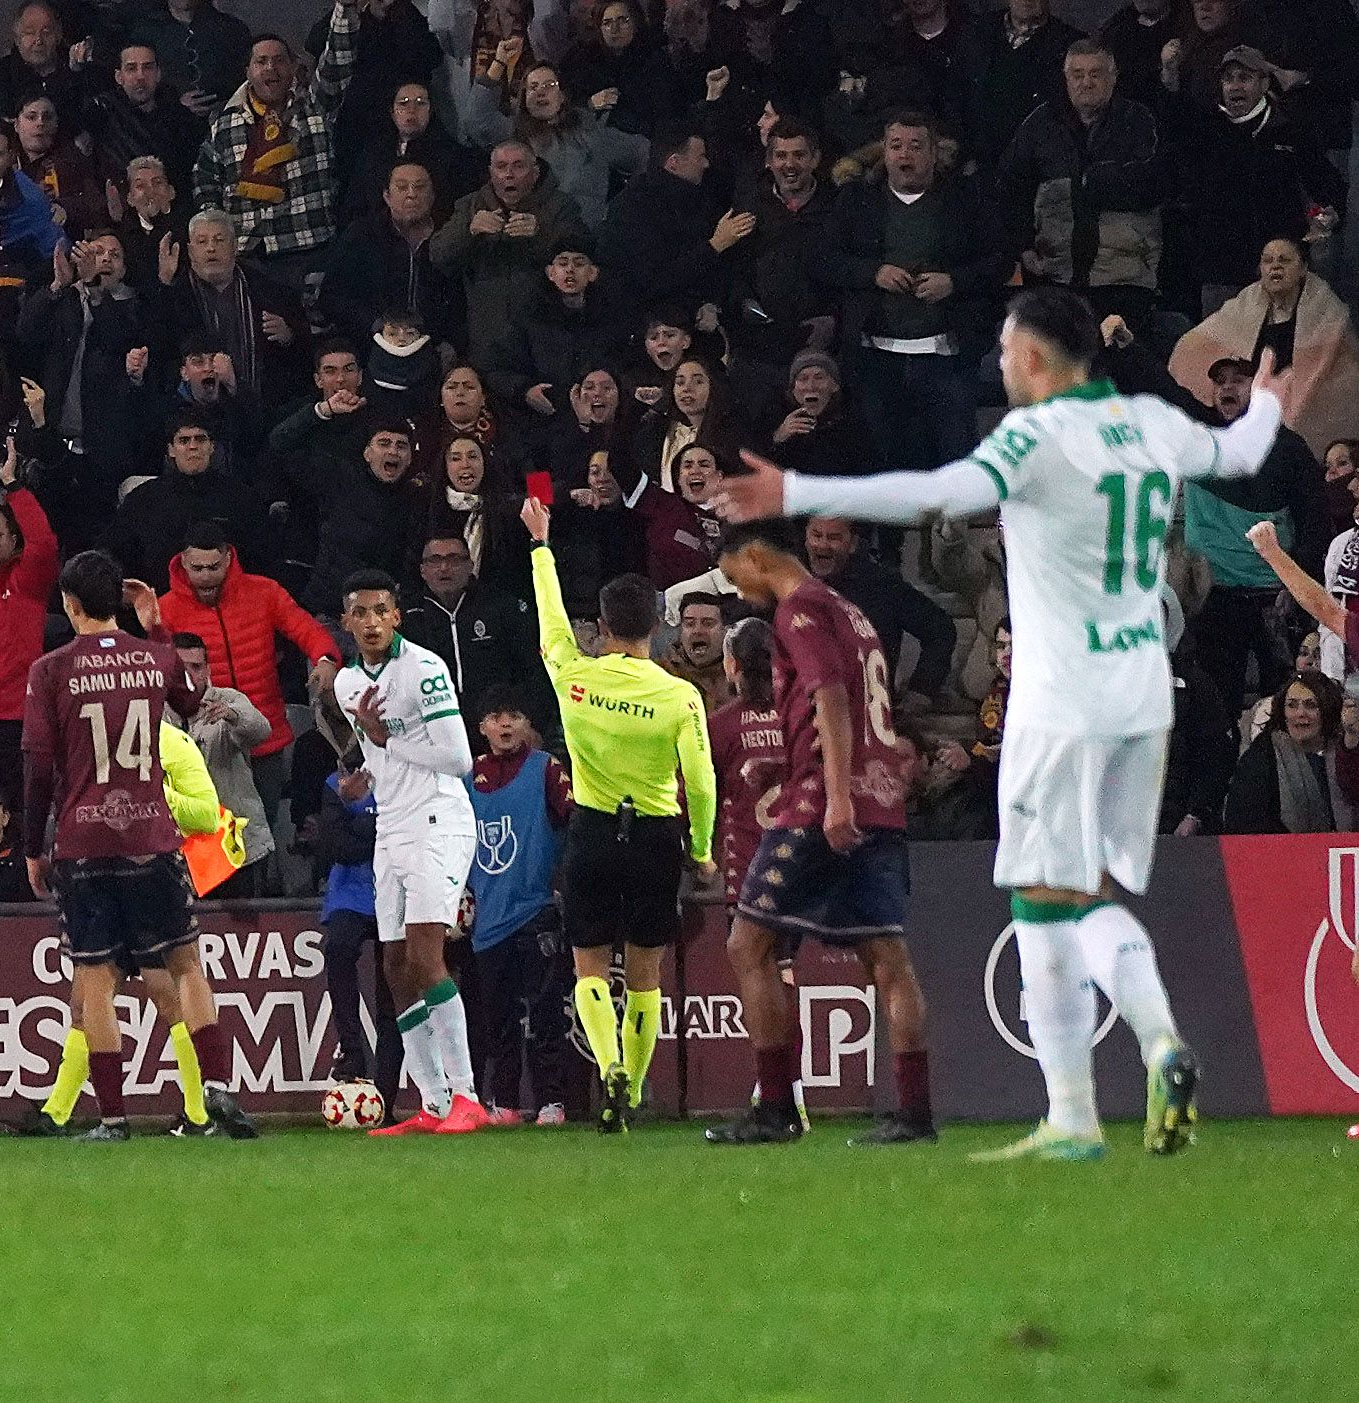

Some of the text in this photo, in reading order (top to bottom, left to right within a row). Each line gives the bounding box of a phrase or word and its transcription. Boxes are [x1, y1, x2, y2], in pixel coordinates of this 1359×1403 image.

[1095, 469, 1172, 595] 16
[69, 670, 165, 696] SAMU MAYO
[588, 692, 655, 720] WÜRTH
[79, 698, 153, 785] 14
